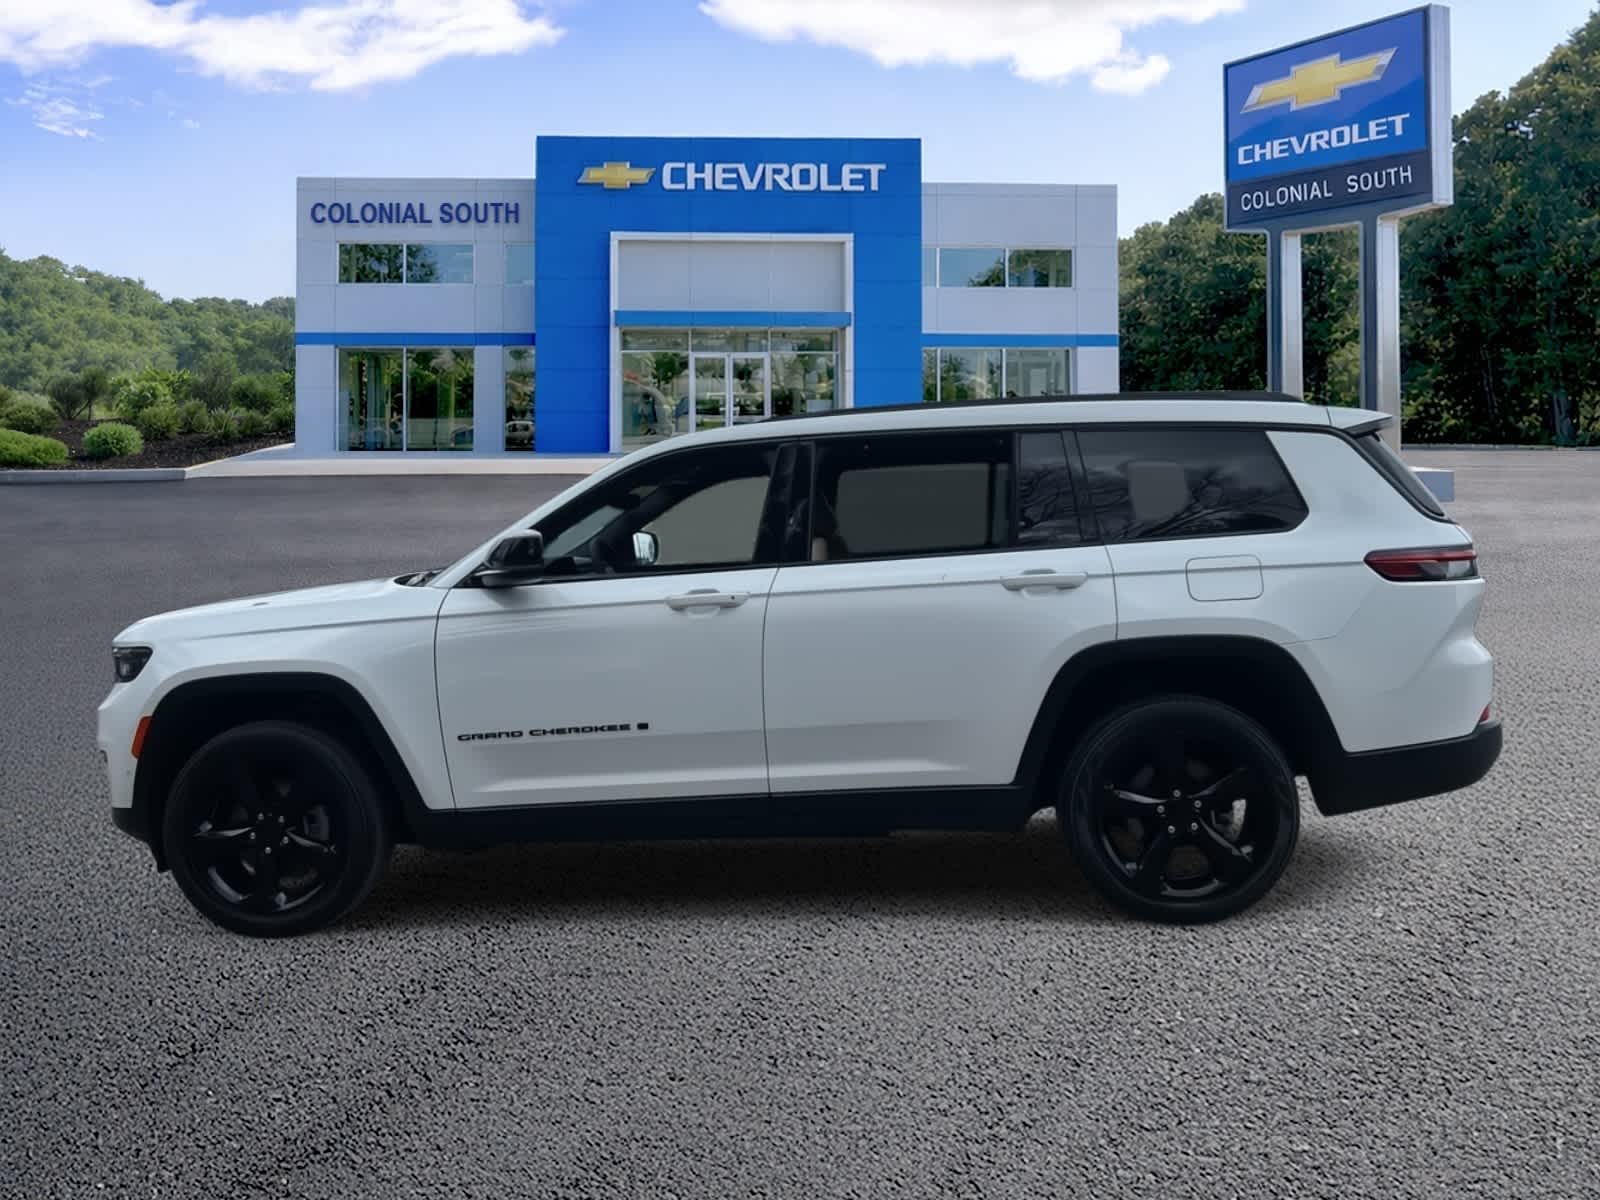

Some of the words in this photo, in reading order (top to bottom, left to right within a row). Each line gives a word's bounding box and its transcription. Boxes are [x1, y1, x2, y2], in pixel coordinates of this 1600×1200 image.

[1238, 113, 1410, 165] CHEVROLET
[662, 162, 886, 191] CHEVROLET
[1241, 181, 1333, 211] COLONIAL
[1346, 166, 1412, 193] SOUTH
[310, 202, 432, 224] COLONIAL
[439, 202, 520, 224] SOUTH
[457, 730, 523, 741] GRAND
[529, 723, 631, 737] CHEROKEE
